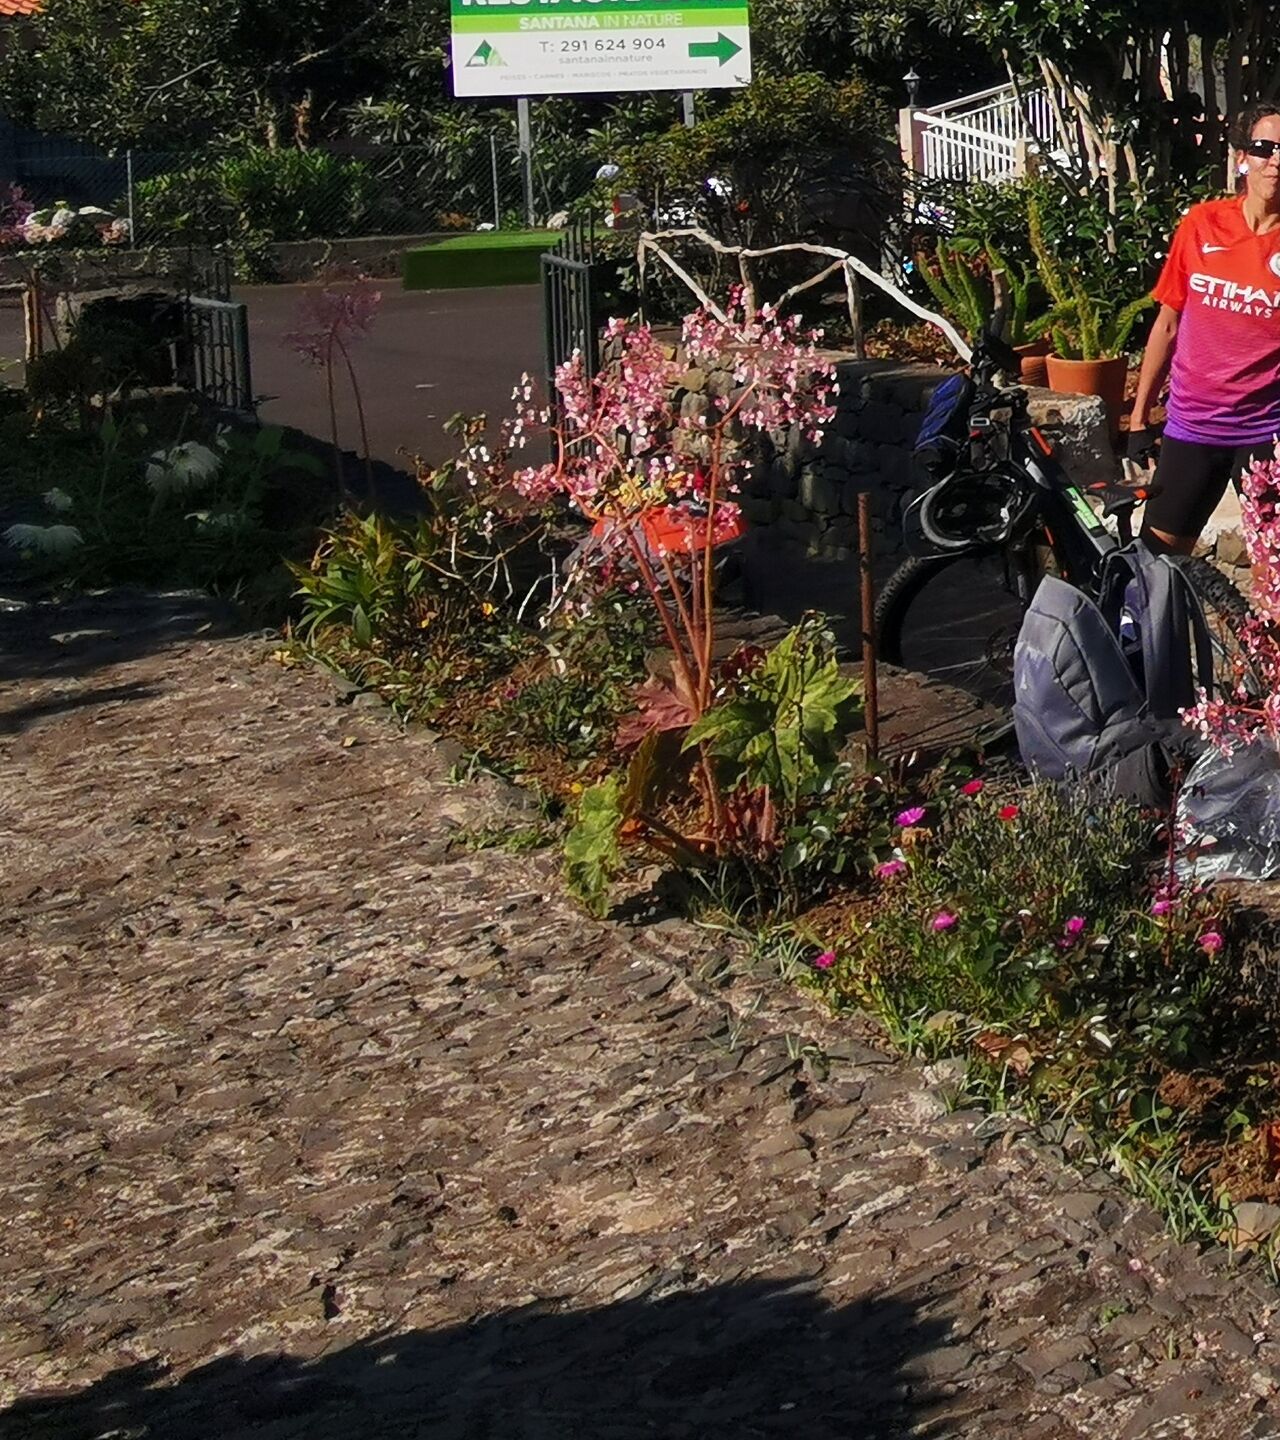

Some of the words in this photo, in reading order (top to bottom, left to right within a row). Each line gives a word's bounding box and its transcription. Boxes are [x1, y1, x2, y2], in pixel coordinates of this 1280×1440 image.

[519, 15, 600, 31] SANTANA
[603, 15, 620, 28] IN
[623, 13, 683, 27] NATURE
[539, 41, 554, 53] T:
[560, 40, 588, 52] 291
[594, 39, 626, 51] 624
[632, 38, 666, 50] 904
[1202, 295, 1273, 319] AIRWAYS
